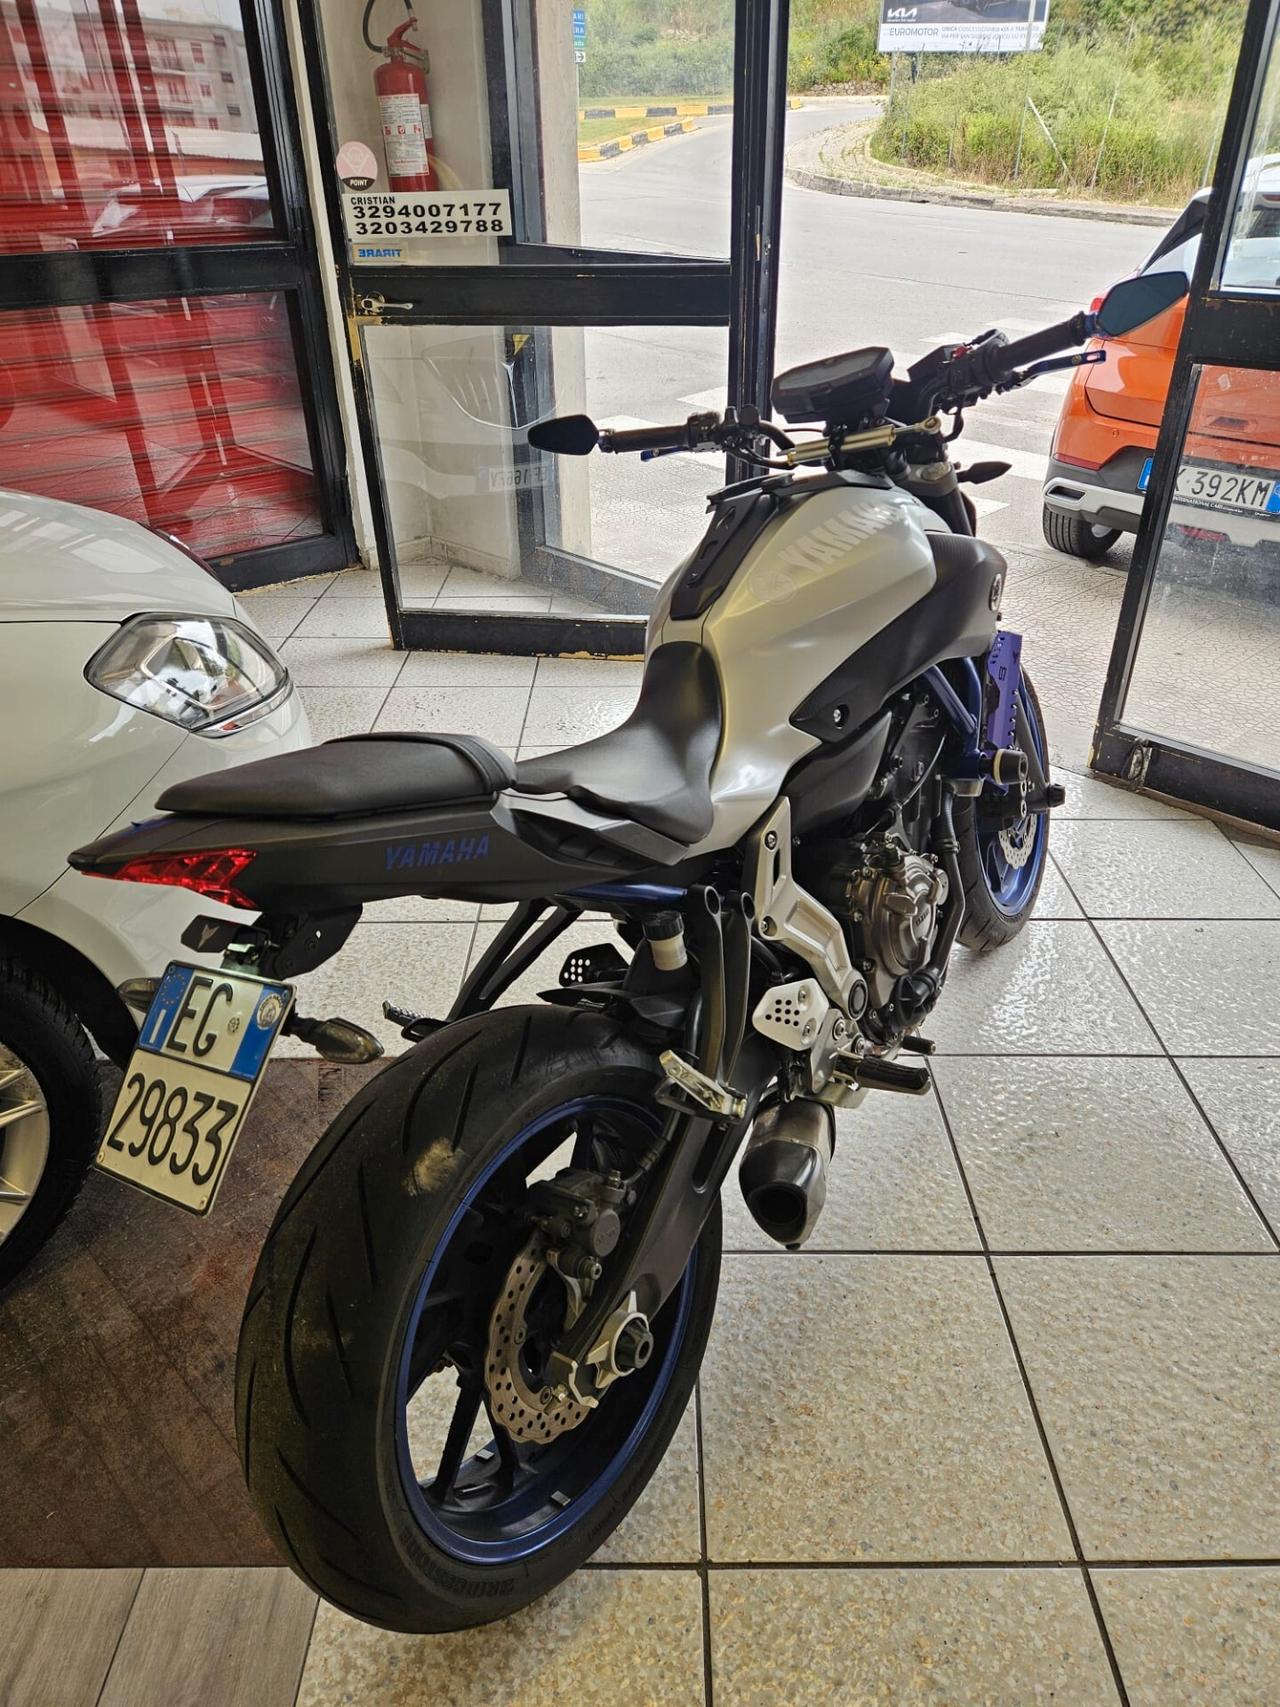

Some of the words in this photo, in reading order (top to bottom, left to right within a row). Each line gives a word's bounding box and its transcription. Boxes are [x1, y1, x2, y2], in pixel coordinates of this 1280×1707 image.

[889, 27, 939, 37] EUROMOTOR
[350, 179, 368, 187] POINT
[351, 196, 396, 205] CRISTIAN
[354, 203, 502, 219] 3294007177
[355, 219, 504, 235] 3203429788
[385, 832, 489, 870] YAMAHA
[166, 975, 234, 1057] EG
[107, 1073, 239, 1186] 29833
